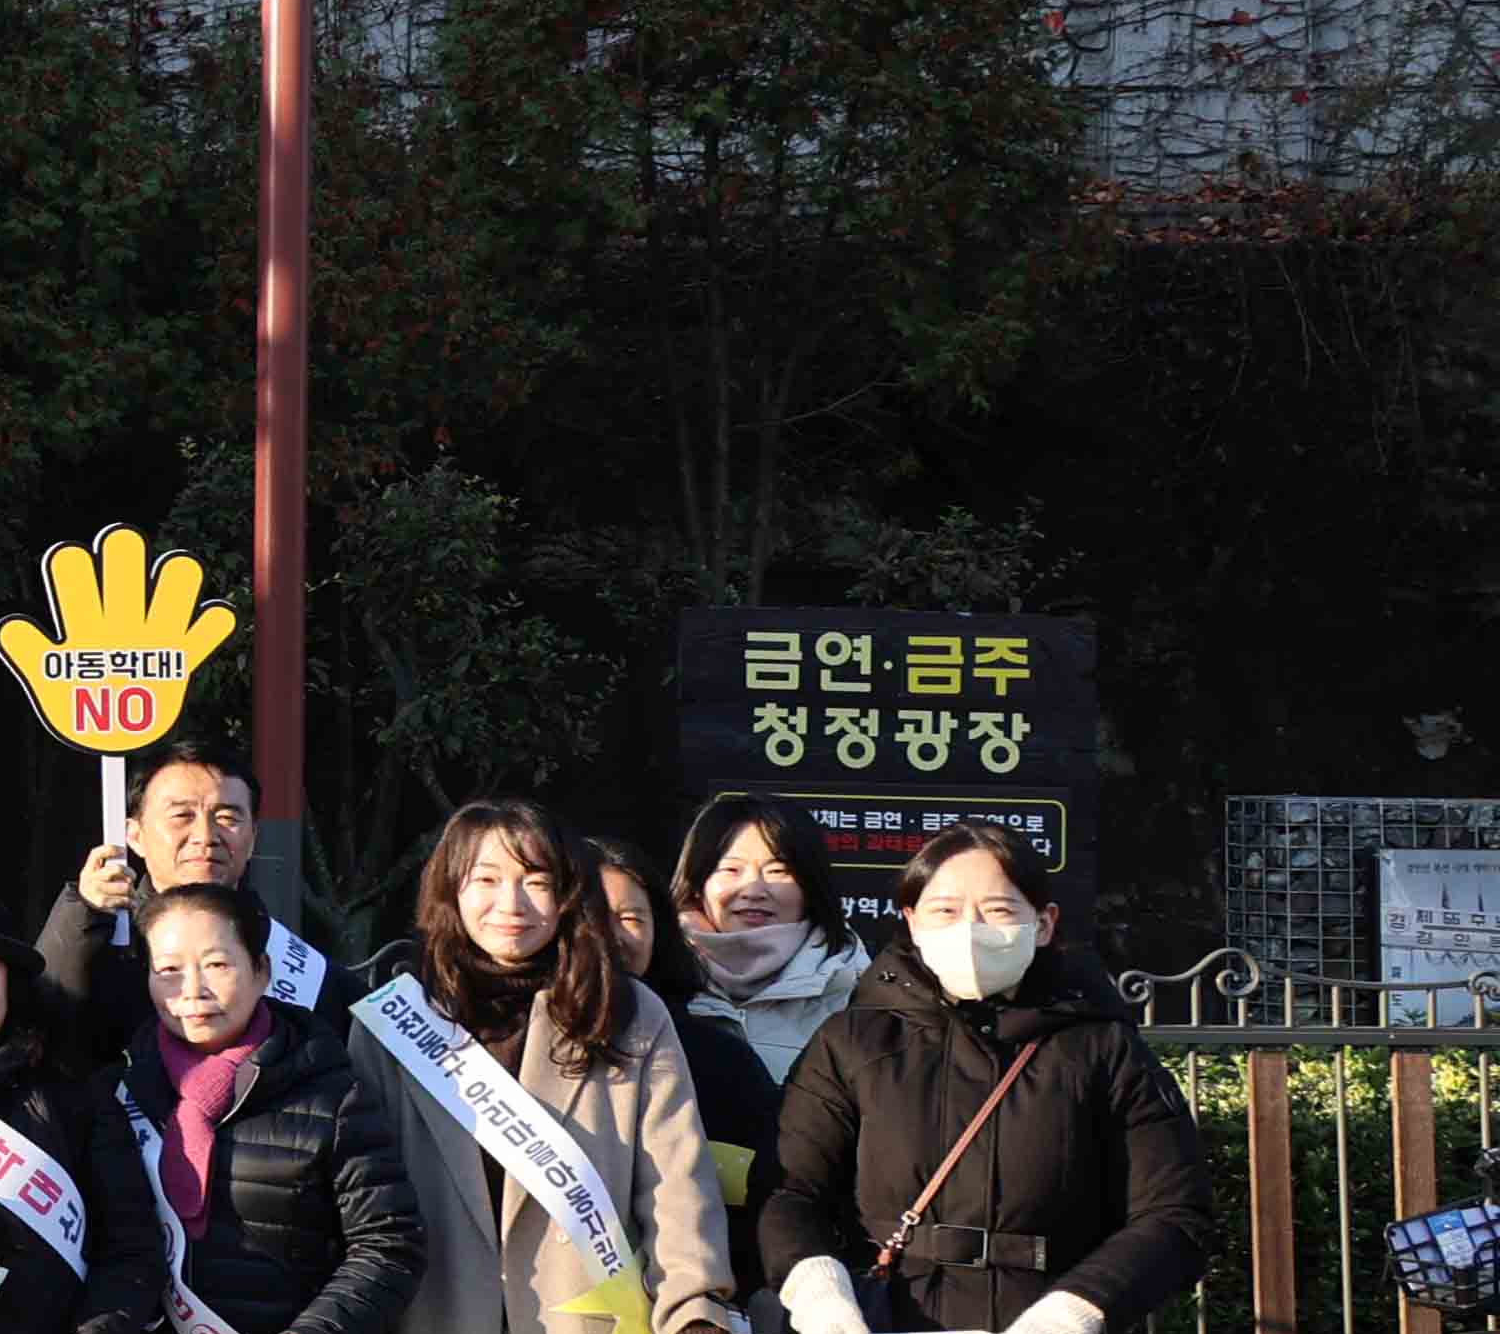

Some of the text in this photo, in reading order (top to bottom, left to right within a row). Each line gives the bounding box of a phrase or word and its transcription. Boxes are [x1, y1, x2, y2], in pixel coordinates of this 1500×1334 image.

[44, 650, 183, 680] 아동학대!
[75, 687, 154, 732] NO
[752, 702, 1031, 774] 청정광장
[864, 811, 903, 830] 금연
